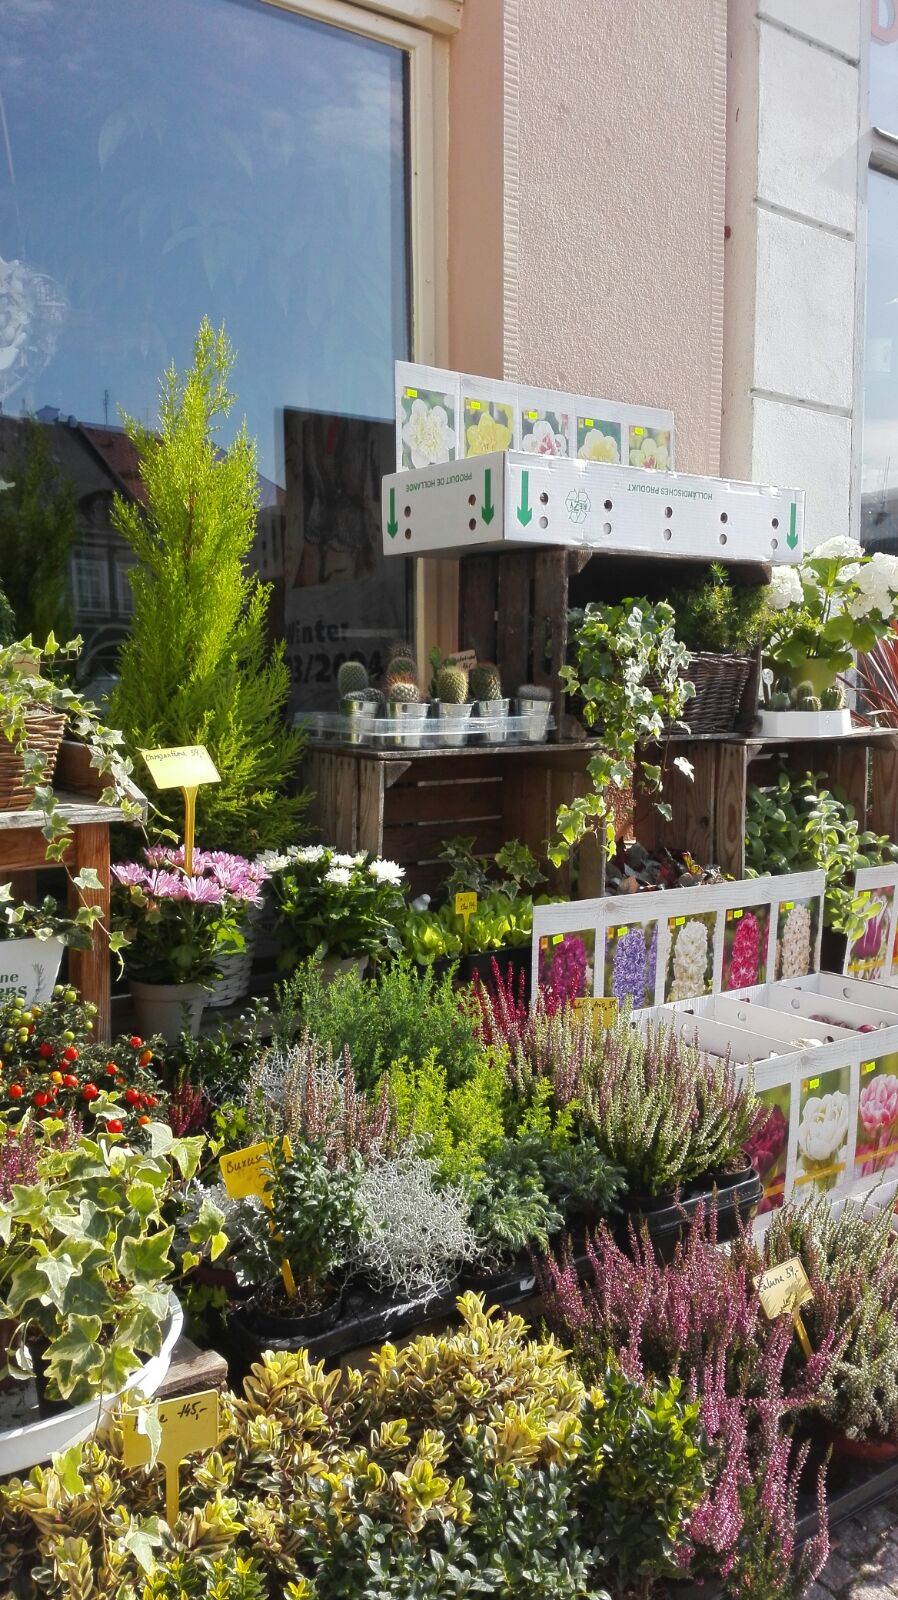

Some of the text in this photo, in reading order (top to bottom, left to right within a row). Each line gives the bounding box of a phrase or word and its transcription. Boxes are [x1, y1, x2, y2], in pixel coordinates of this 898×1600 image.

[405, 472, 472, 492] PRODUIT DE HOLLANDE
[627, 483, 713, 500] HOLLÄNDISCHES PRODUKT
[226, 1155, 261, 1174] Buxus
